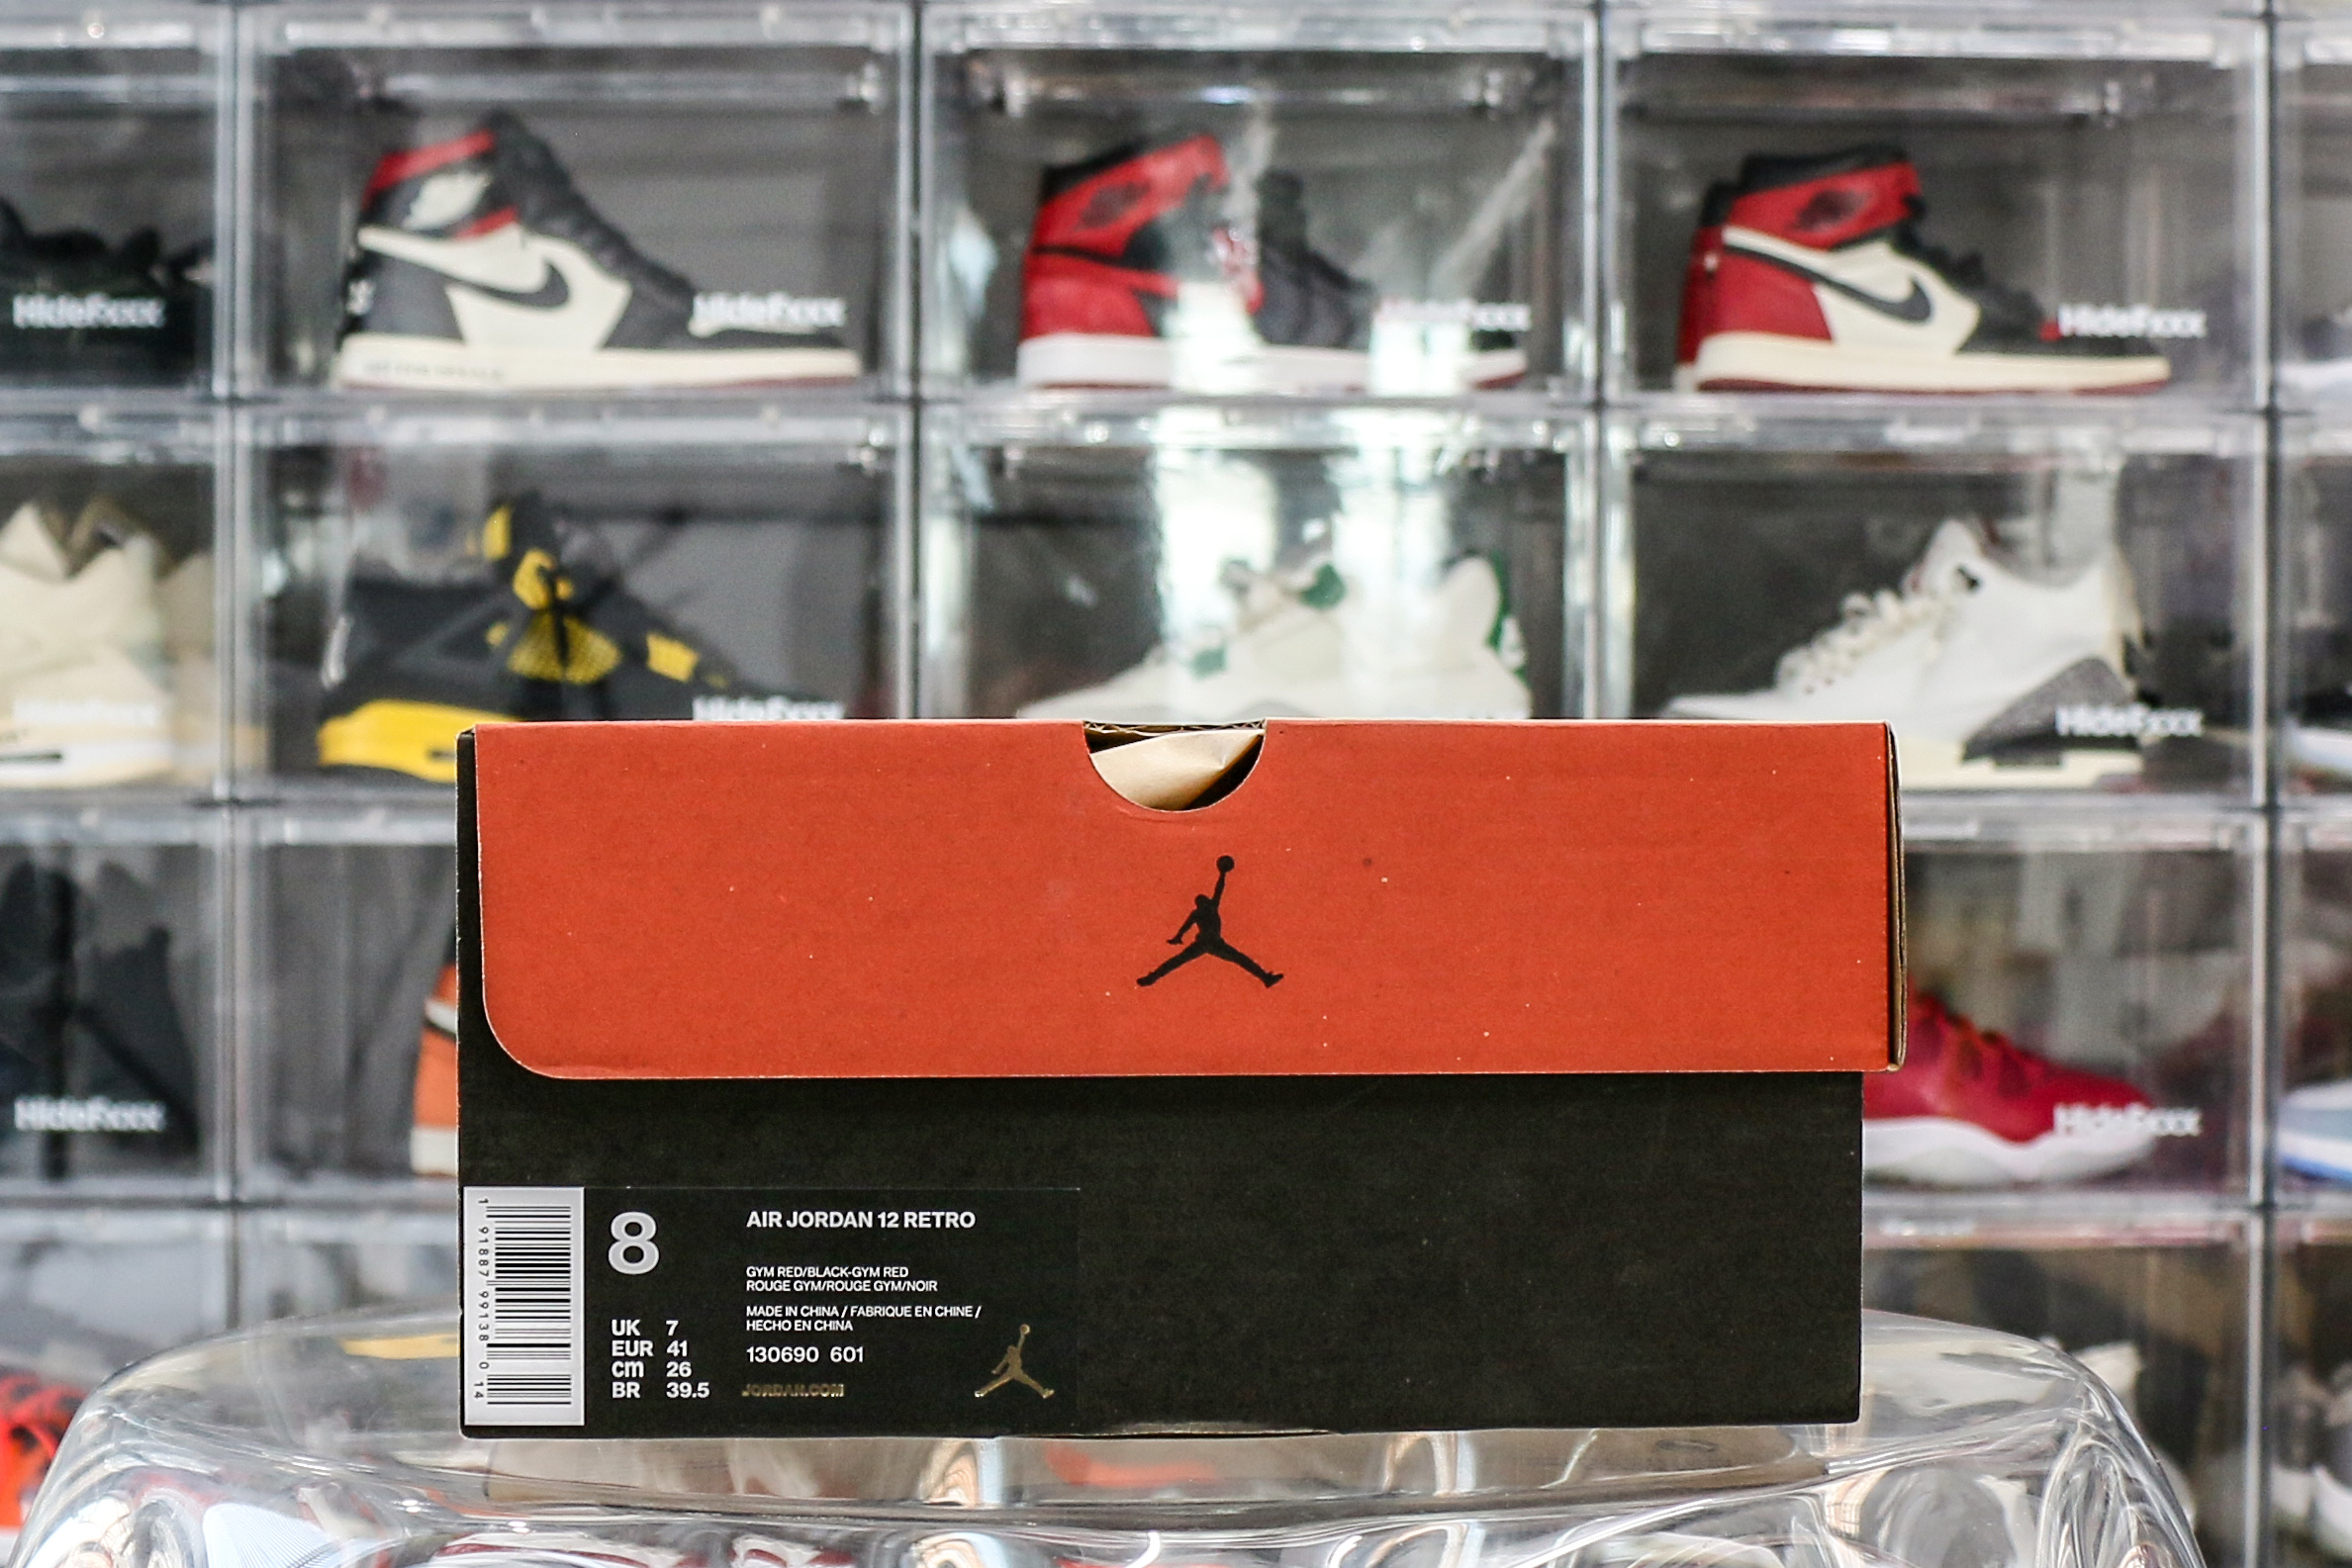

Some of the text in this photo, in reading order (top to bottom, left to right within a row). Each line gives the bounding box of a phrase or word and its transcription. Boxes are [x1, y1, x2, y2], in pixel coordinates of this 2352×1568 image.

[746, 1211, 977, 1229] AIR JORDAN 12 RETRO
[478, 1227, 490, 1277] 91887
[608, 1211, 660, 1275] 8
[746, 1265, 909, 1278] GYM RED/BLACK-GYM RED
[746, 1280, 938, 1292] ROUGE GYM/ROUGE GYM/NOIR
[478, 1291, 490, 1341] 99138
[746, 1305, 783, 1318] MADE
[785, 1305, 799, 1318] IN
[800, 1305, 840, 1318] CHINA
[850, 1305, 912, 1318] FABRIQUE
[914, 1305, 932, 1318] EN
[934, 1305, 974, 1318] CHINE
[612, 1319, 679, 1337] UK 7
[746, 1320, 854, 1332] HECHO EN CHINA
[612, 1339, 688, 1357] EUR 41
[746, 1345, 864, 1363] 130690 601
[666, 1360, 693, 1378] 26
[474, 1381, 485, 1399] 14
[612, 1381, 710, 1399] BR 39.5
[741, 1383, 844, 1398] JORDAN.COM
